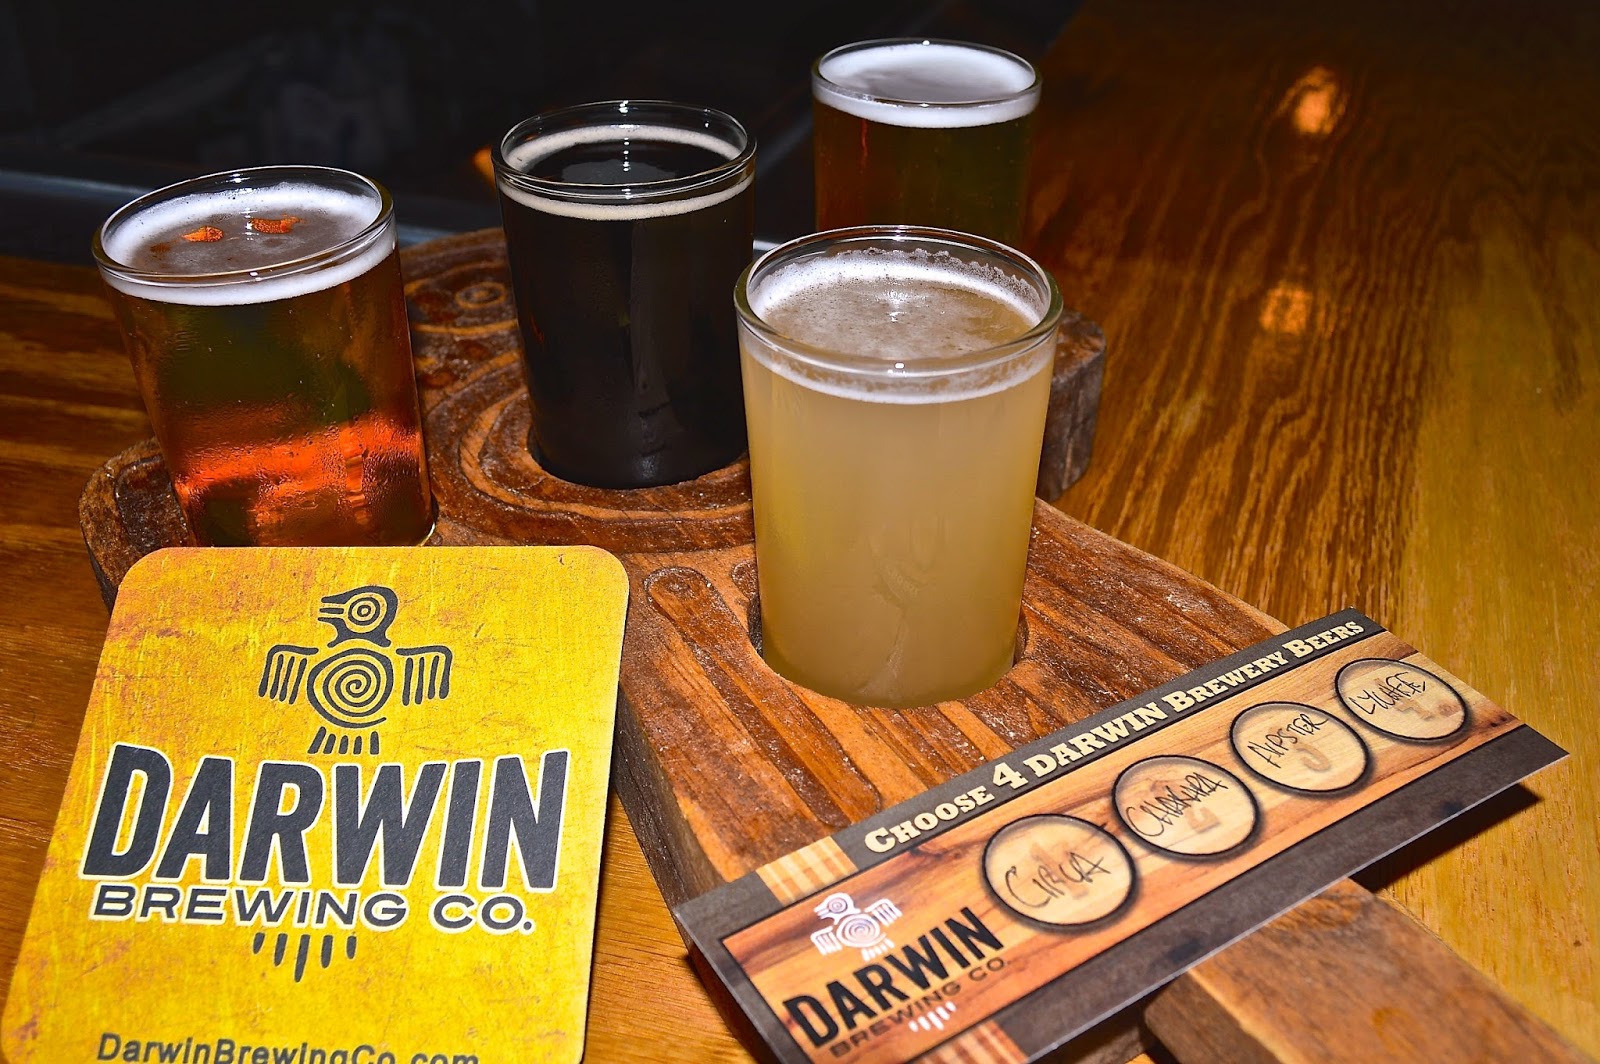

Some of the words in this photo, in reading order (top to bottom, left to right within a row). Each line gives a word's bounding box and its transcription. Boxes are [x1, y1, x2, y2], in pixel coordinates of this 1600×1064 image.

[864, 785, 995, 853] CHOOSE
[991, 761, 1029, 790] 4
[1023, 701, 1169, 778] DARWIN
[1161, 650, 1289, 713] BREWERY
[1282, 621, 1366, 659] BEERS
[79, 743, 569, 894] DARWIN
[90, 884, 407, 926] BREWING
[432, 893, 536, 935] CO.
[782, 906, 1005, 1048] DARWIN
[829, 981, 962, 1058] BREWING
[97, 1032, 479, 1064] DarwinBrewingCocom
